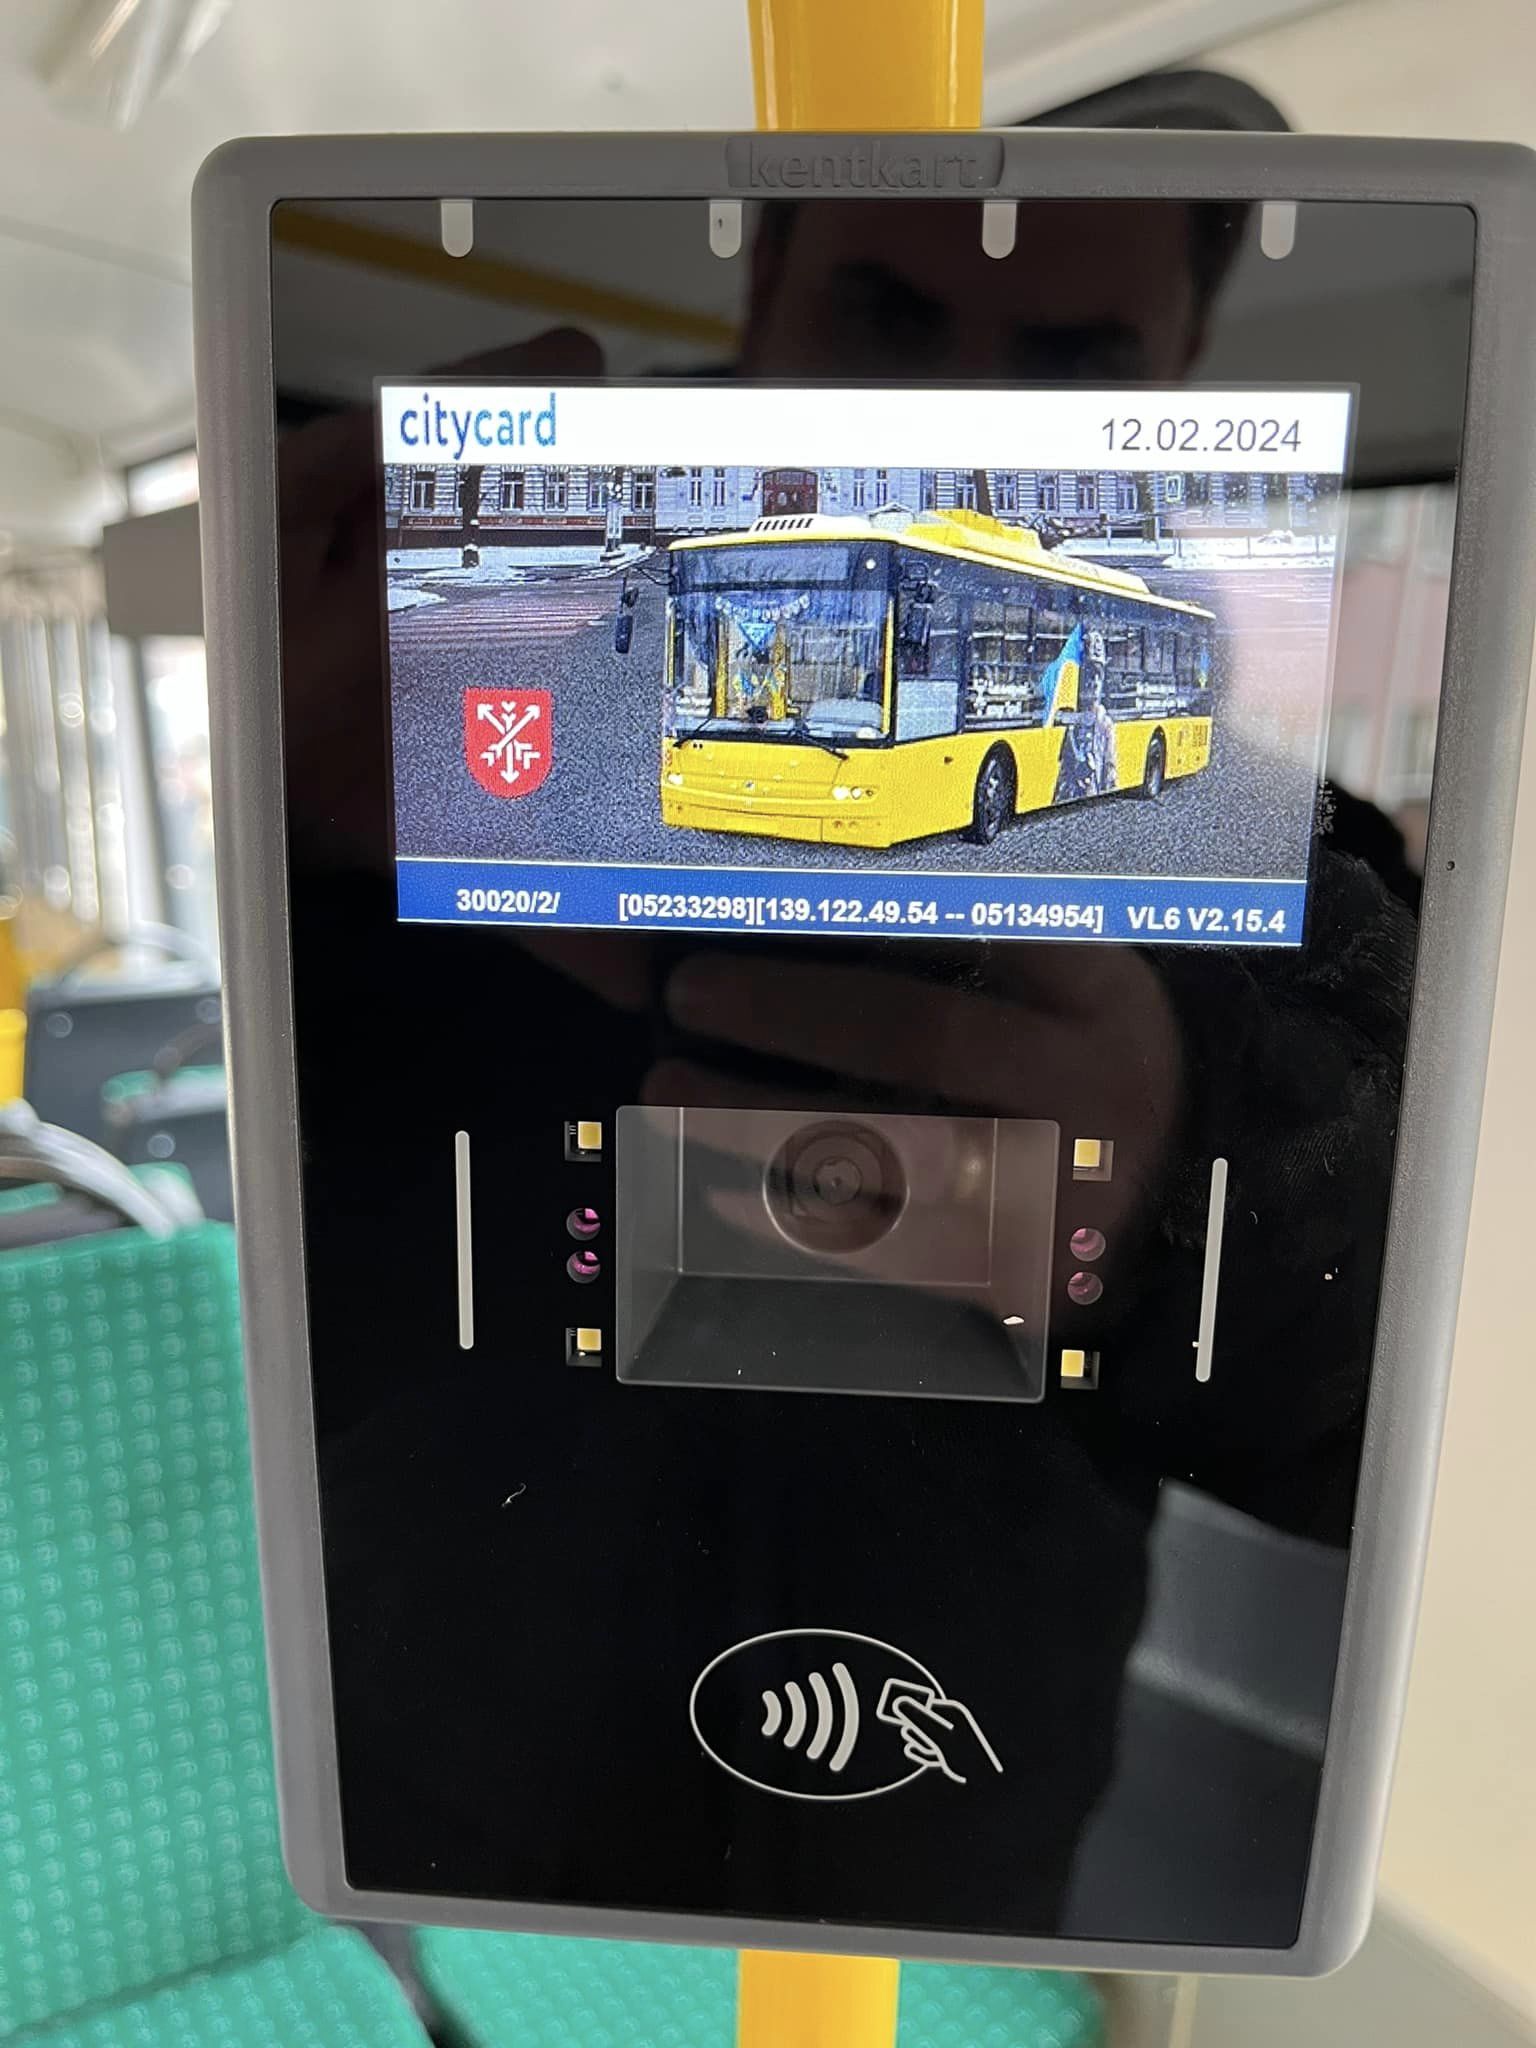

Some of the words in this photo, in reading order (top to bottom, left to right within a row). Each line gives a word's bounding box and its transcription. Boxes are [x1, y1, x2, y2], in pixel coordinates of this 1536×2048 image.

[750, 139, 978, 189] kentkart
[400, 393, 556, 460] citycard
[1101, 418, 1302, 453] 12.02.2024
[456, 889, 561, 914] 30020/2/
[971, 903, 1104, 933] 05134954]
[1128, 905, 1181, 931] VL6
[1187, 906, 1286, 933] V2.15.4
